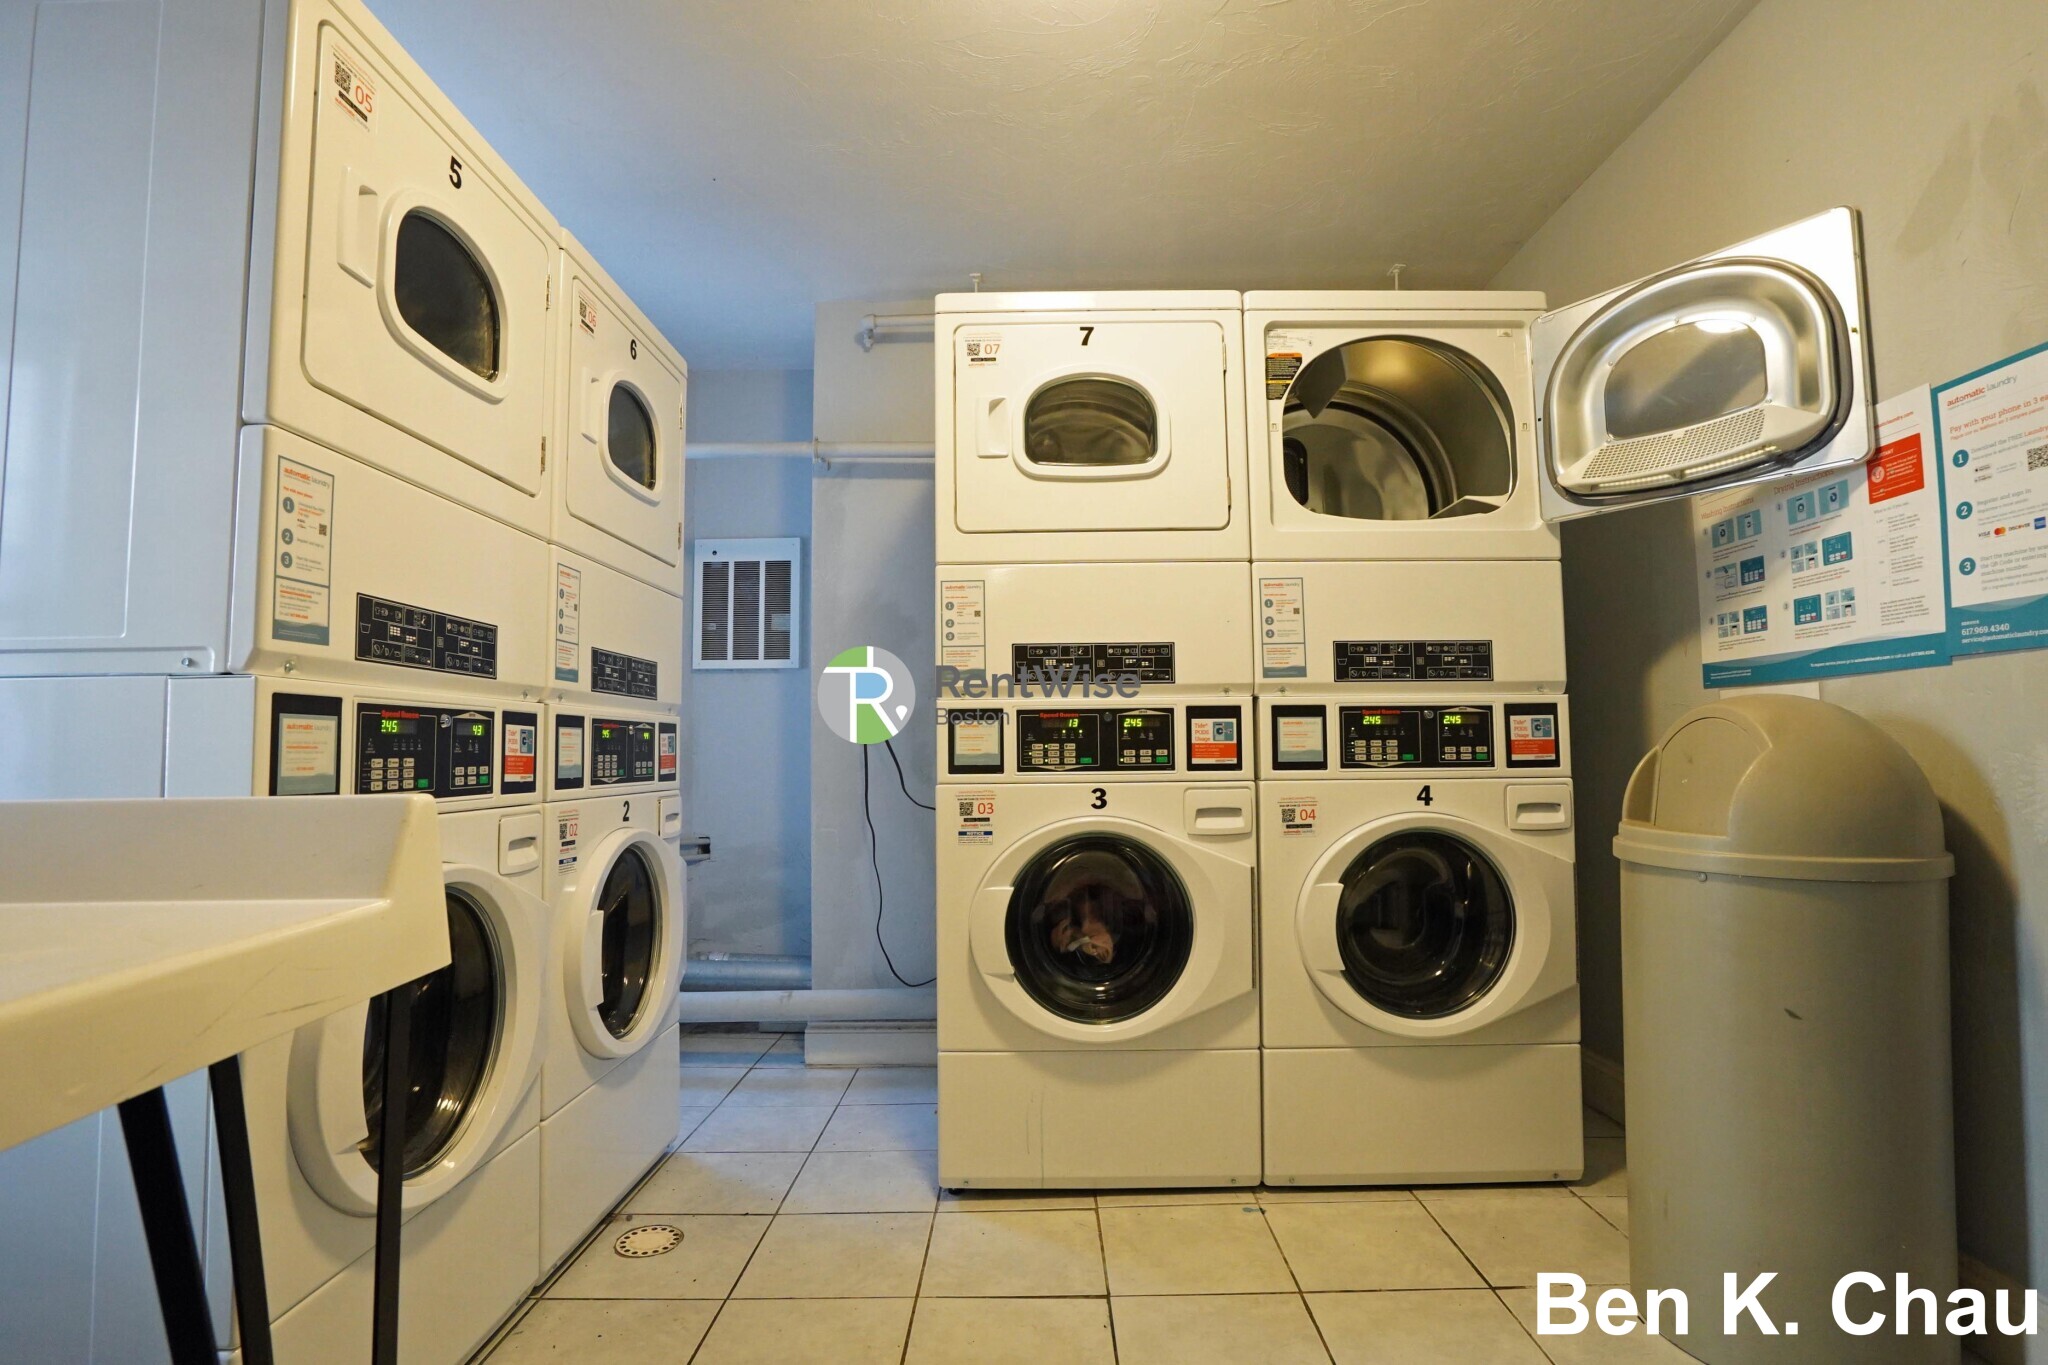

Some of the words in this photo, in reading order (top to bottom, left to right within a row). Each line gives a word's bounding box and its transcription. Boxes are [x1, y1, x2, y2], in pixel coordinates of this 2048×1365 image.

[356, 85, 372, 113] 05
[449, 155, 462, 189] 5
[1080, 326, 1094, 346] 7
[630, 338, 638, 360] 6
[984, 344, 1000, 354] 07
[1946, 386, 1986, 407] automatic
[1987, 375, 2018, 392] laundry
[1950, 424, 1962, 434] Pay
[1964, 415, 1980, 428] with
[1980, 413, 1996, 425] your
[1998, 404, 2022, 418] phone
[1958, 454, 1964, 463] 1
[284, 467, 311, 482] automatic
[312, 475, 330, 489] laundry
[1774, 484, 1794, 496] Drying
[1795, 469, 1834, 490] Instructions
[286, 501, 291, 510] 1
[1961, 506, 1968, 516] 2
[285, 532, 290, 541] 2
[284, 555, 290, 565] 3
[1964, 562, 1971, 572] 3
[1962, 623, 2010, 636] 617.969.4340
[1069, 719, 1079, 727] 13
[472, 725, 483, 736] 43
[1091, 788, 1107, 809] 3
[1417, 785, 1433, 806] 4
[623, 800, 630, 822] 2
[978, 802, 994, 815] 03
[1300, 809, 1316, 821] 04
[569, 823, 578, 837] 02
